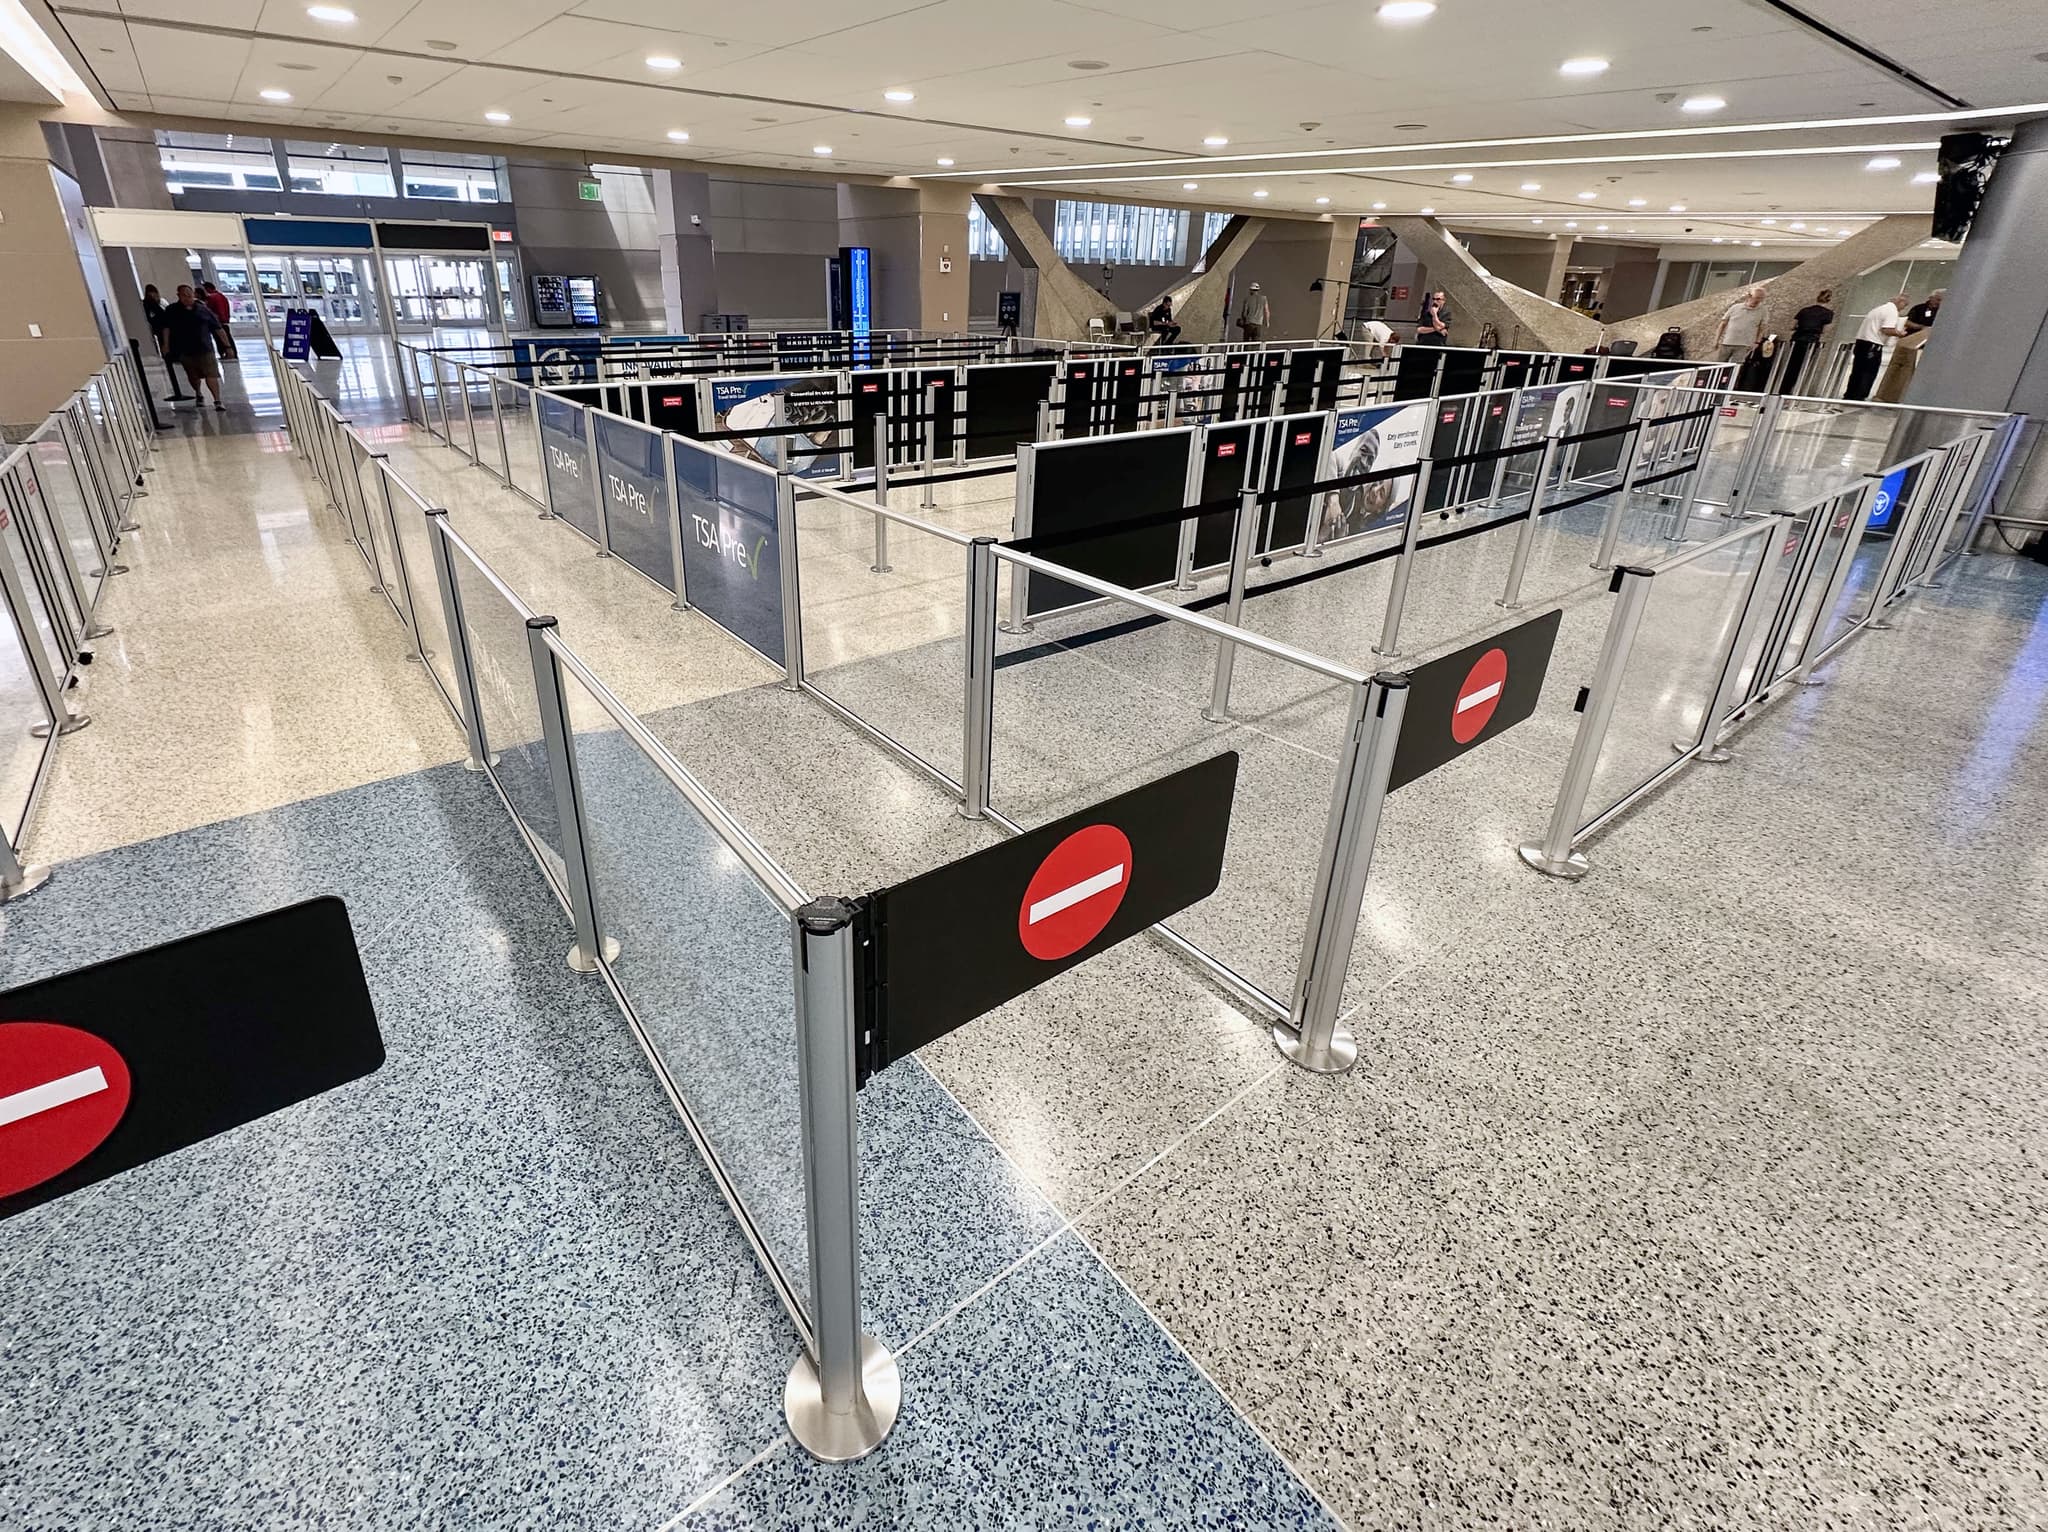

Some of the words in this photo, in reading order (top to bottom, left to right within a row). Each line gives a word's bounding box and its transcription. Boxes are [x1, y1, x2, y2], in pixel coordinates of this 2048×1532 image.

[715, 386, 730, 395] TSA
[730, 385, 742, 394] Pre
[549, 446, 565, 469] TSA
[564, 456, 579, 478] Pre
[608, 474, 628, 505] TSA
[628, 485, 647, 514] Pre
[691, 513, 721, 554] TSA
[722, 530, 748, 568] Pre
